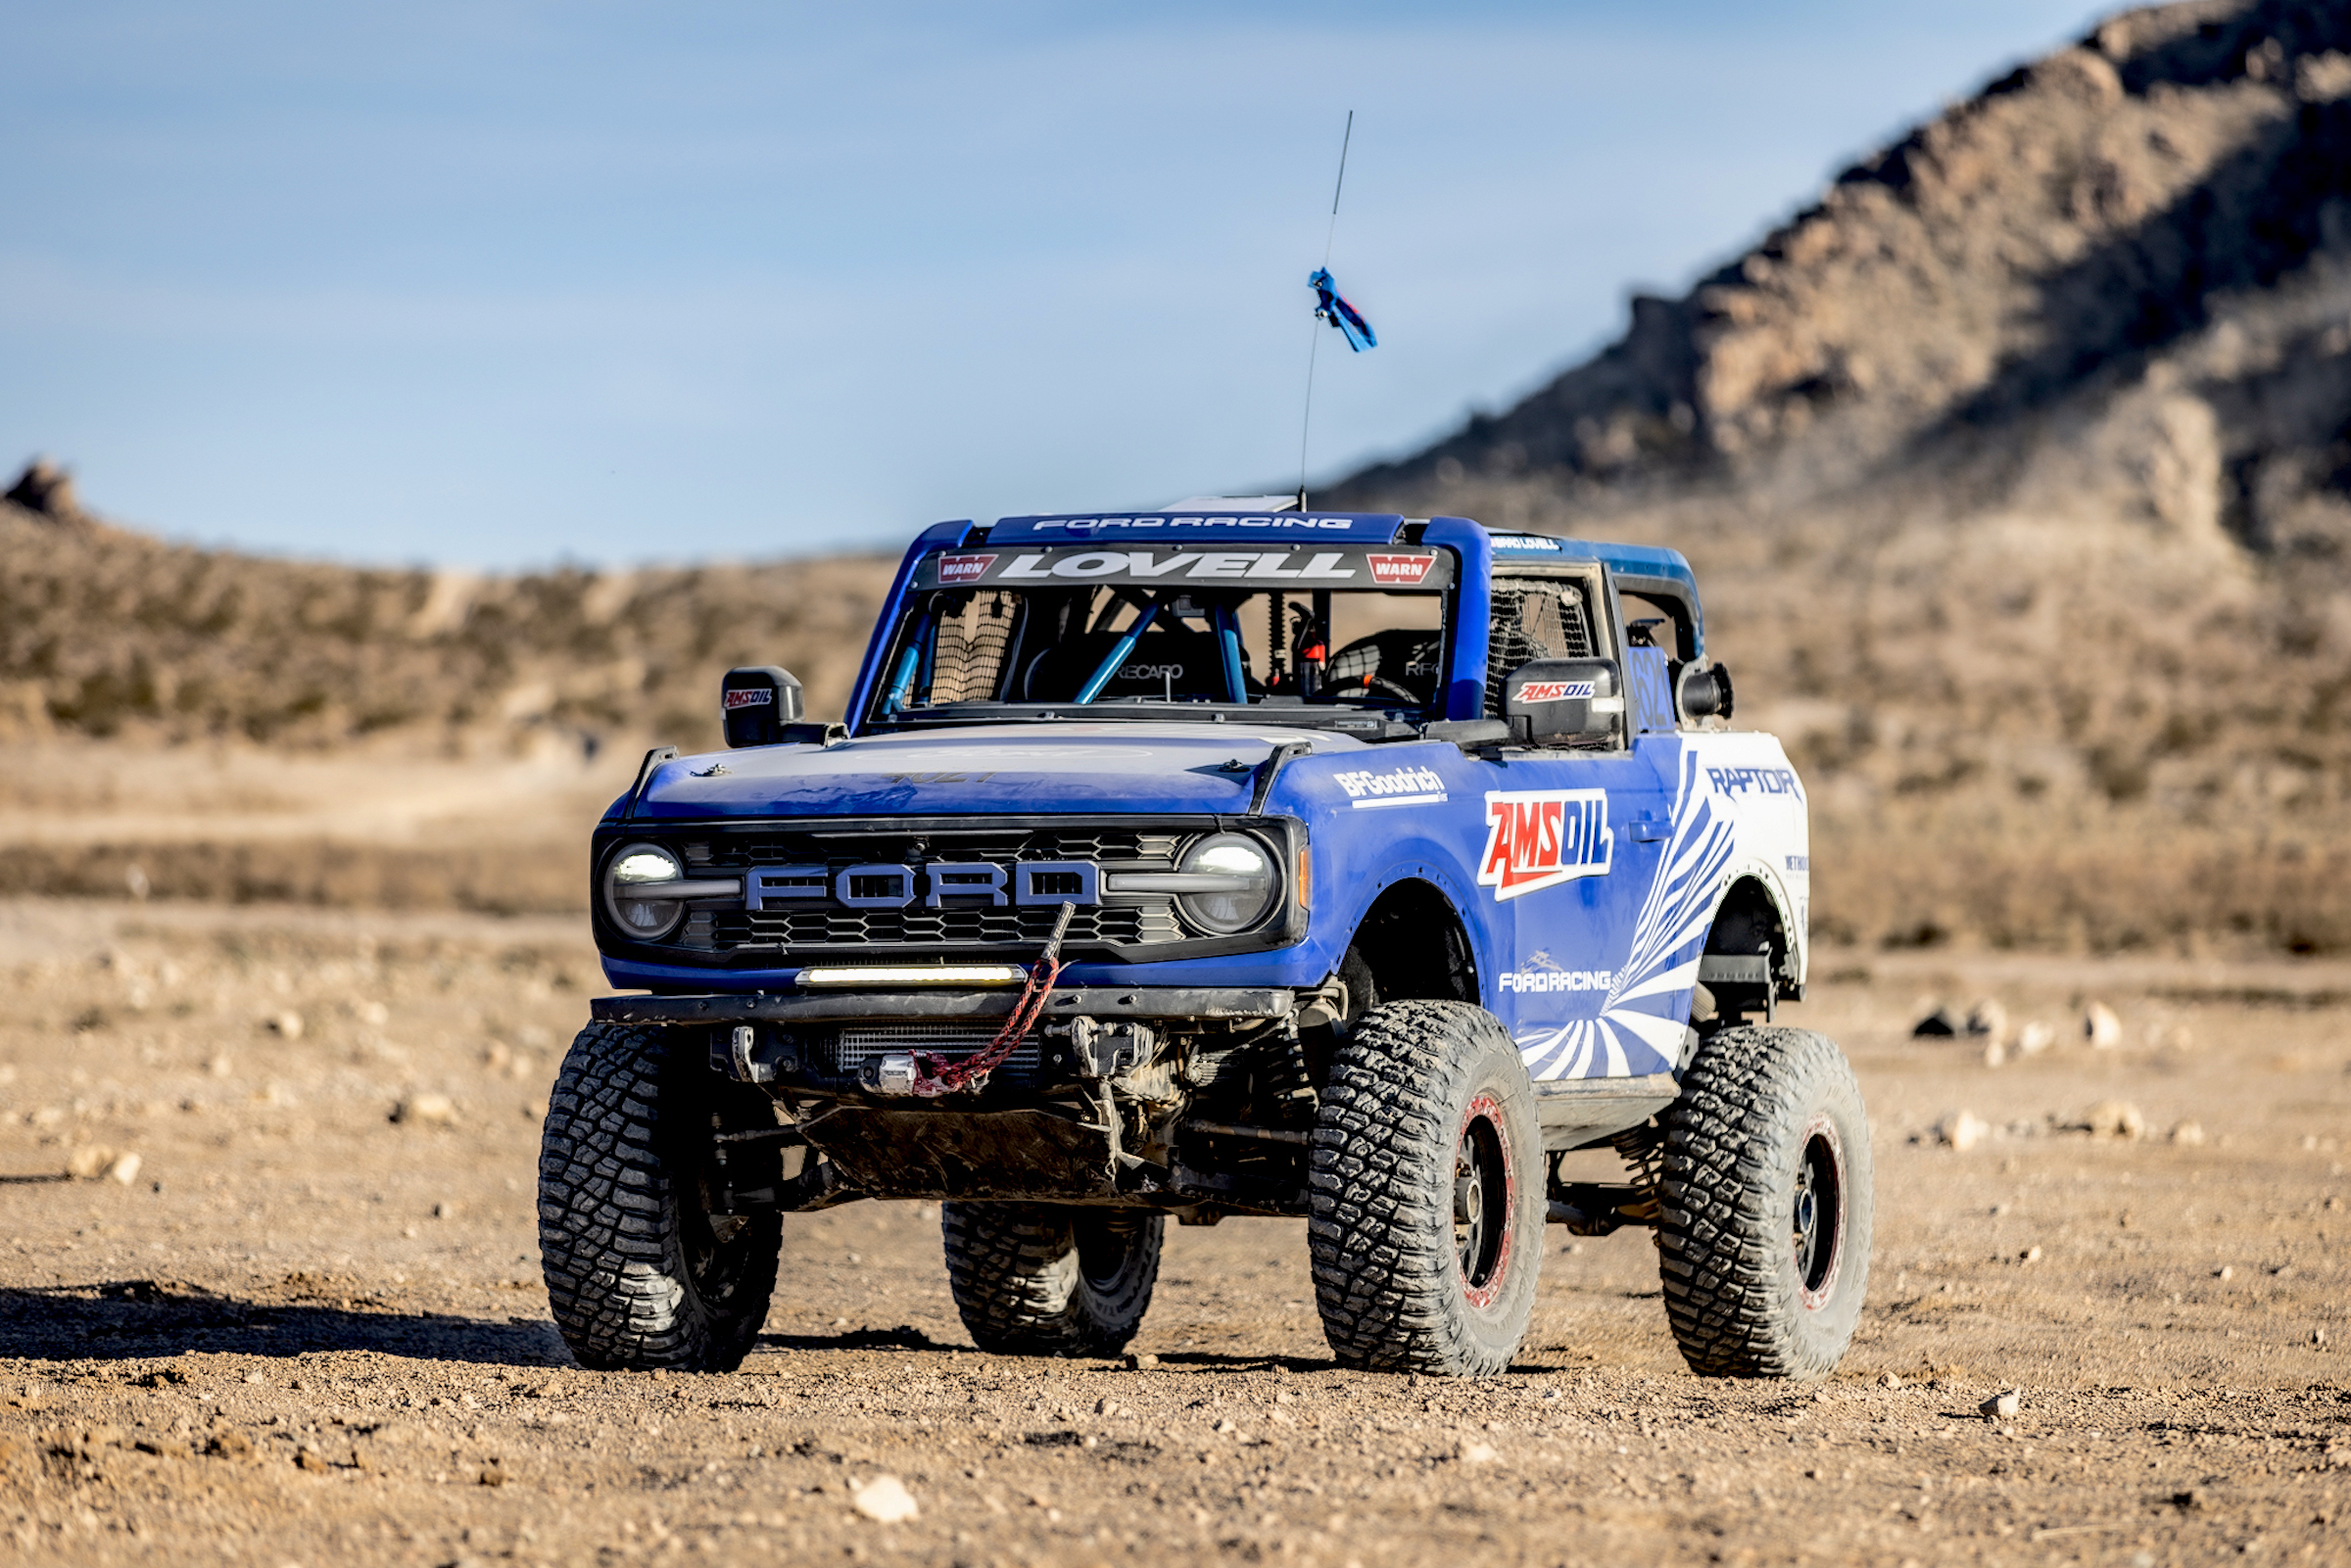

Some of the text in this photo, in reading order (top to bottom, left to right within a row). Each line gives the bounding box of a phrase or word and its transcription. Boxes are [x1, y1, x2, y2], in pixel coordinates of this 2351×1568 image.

[1032, 516, 1354, 531] FORD RACING
[942, 562, 984, 576] WARN
[997, 551, 1357, 579] LOVELL
[1376, 563, 1423, 576] WARN
[727, 690, 770, 707] AMSOIL
[1518, 684, 1594, 701] AMSOIL
[1333, 766, 1446, 797] BFGoodrich
[1705, 768, 1802, 803] RAPTOR
[1485, 799, 1609, 889] AMSOIL
[745, 861, 1103, 911] FORD
[1499, 971, 1611, 993] FORD RACING
